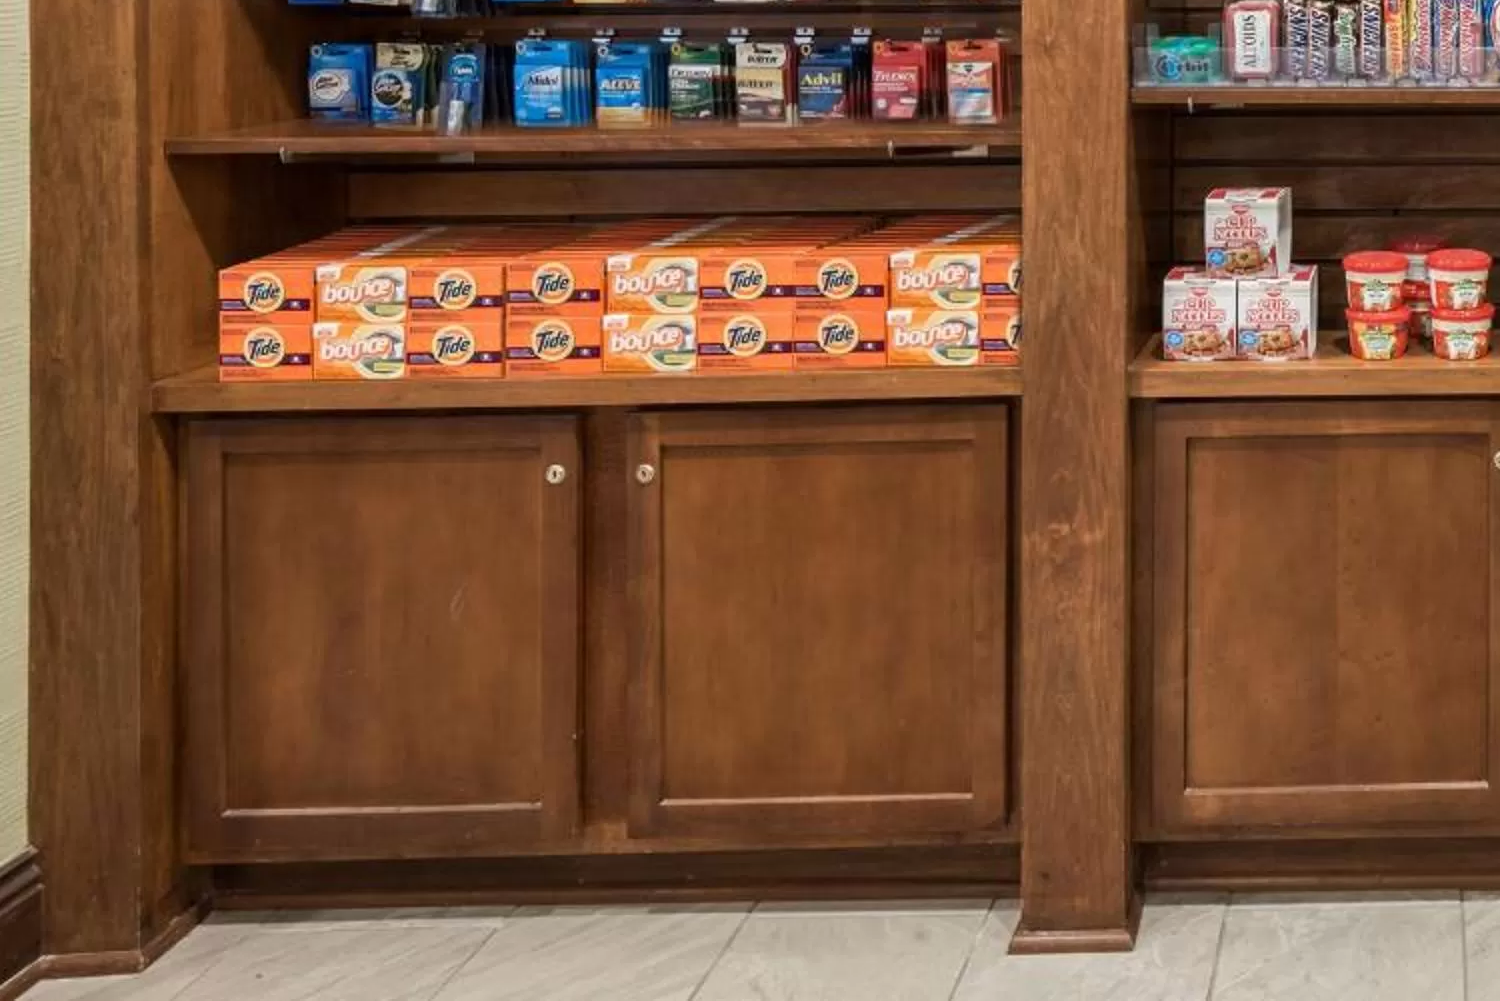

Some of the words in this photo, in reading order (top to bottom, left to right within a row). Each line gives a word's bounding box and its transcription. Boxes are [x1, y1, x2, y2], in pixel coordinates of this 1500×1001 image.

[1363, 2, 1380, 74] SNICKERS
[802, 73, 844, 87] Advil
[536, 275, 570, 296] Tide
[729, 269, 763, 291] Tide
[820, 269, 854, 289] Tide
[247, 283, 281, 302] Tide
[322, 276, 395, 305] bounce
[437, 281, 473, 302] Tide
[436, 335, 472, 357] Tide
[535, 331, 570, 353] Tide
[727, 326, 761, 347] Tide
[821, 326, 854, 347] Tide
[247, 338, 281, 357] Tide
